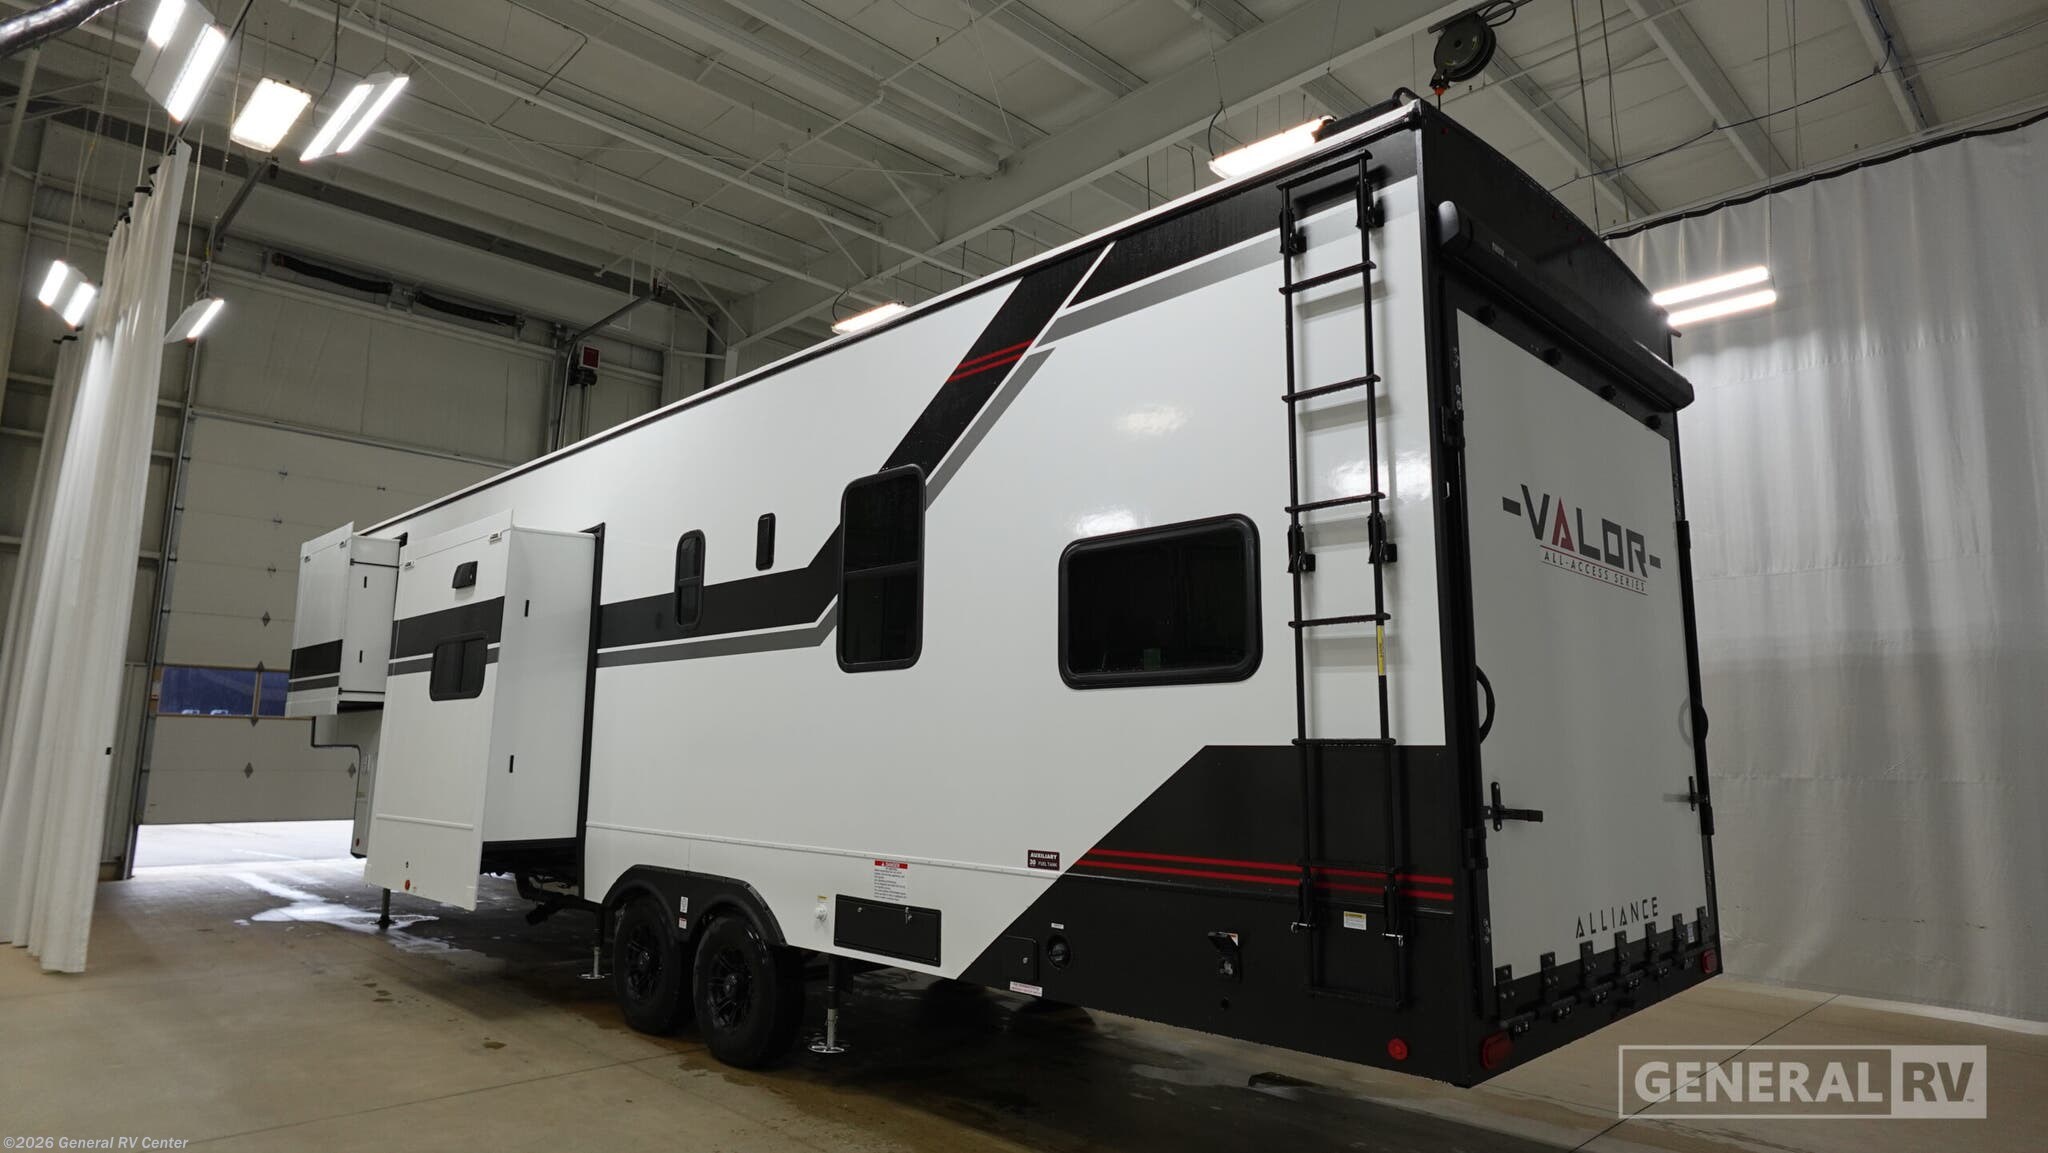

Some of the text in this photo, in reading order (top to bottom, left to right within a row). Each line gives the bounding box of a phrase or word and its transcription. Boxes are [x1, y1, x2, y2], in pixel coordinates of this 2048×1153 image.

[1544, 551, 1645, 592] ALL-ACCESS SERIES
[1030, 852, 1057, 860] AUXILIARY
[1576, 896, 1659, 939] ALLIANCE
